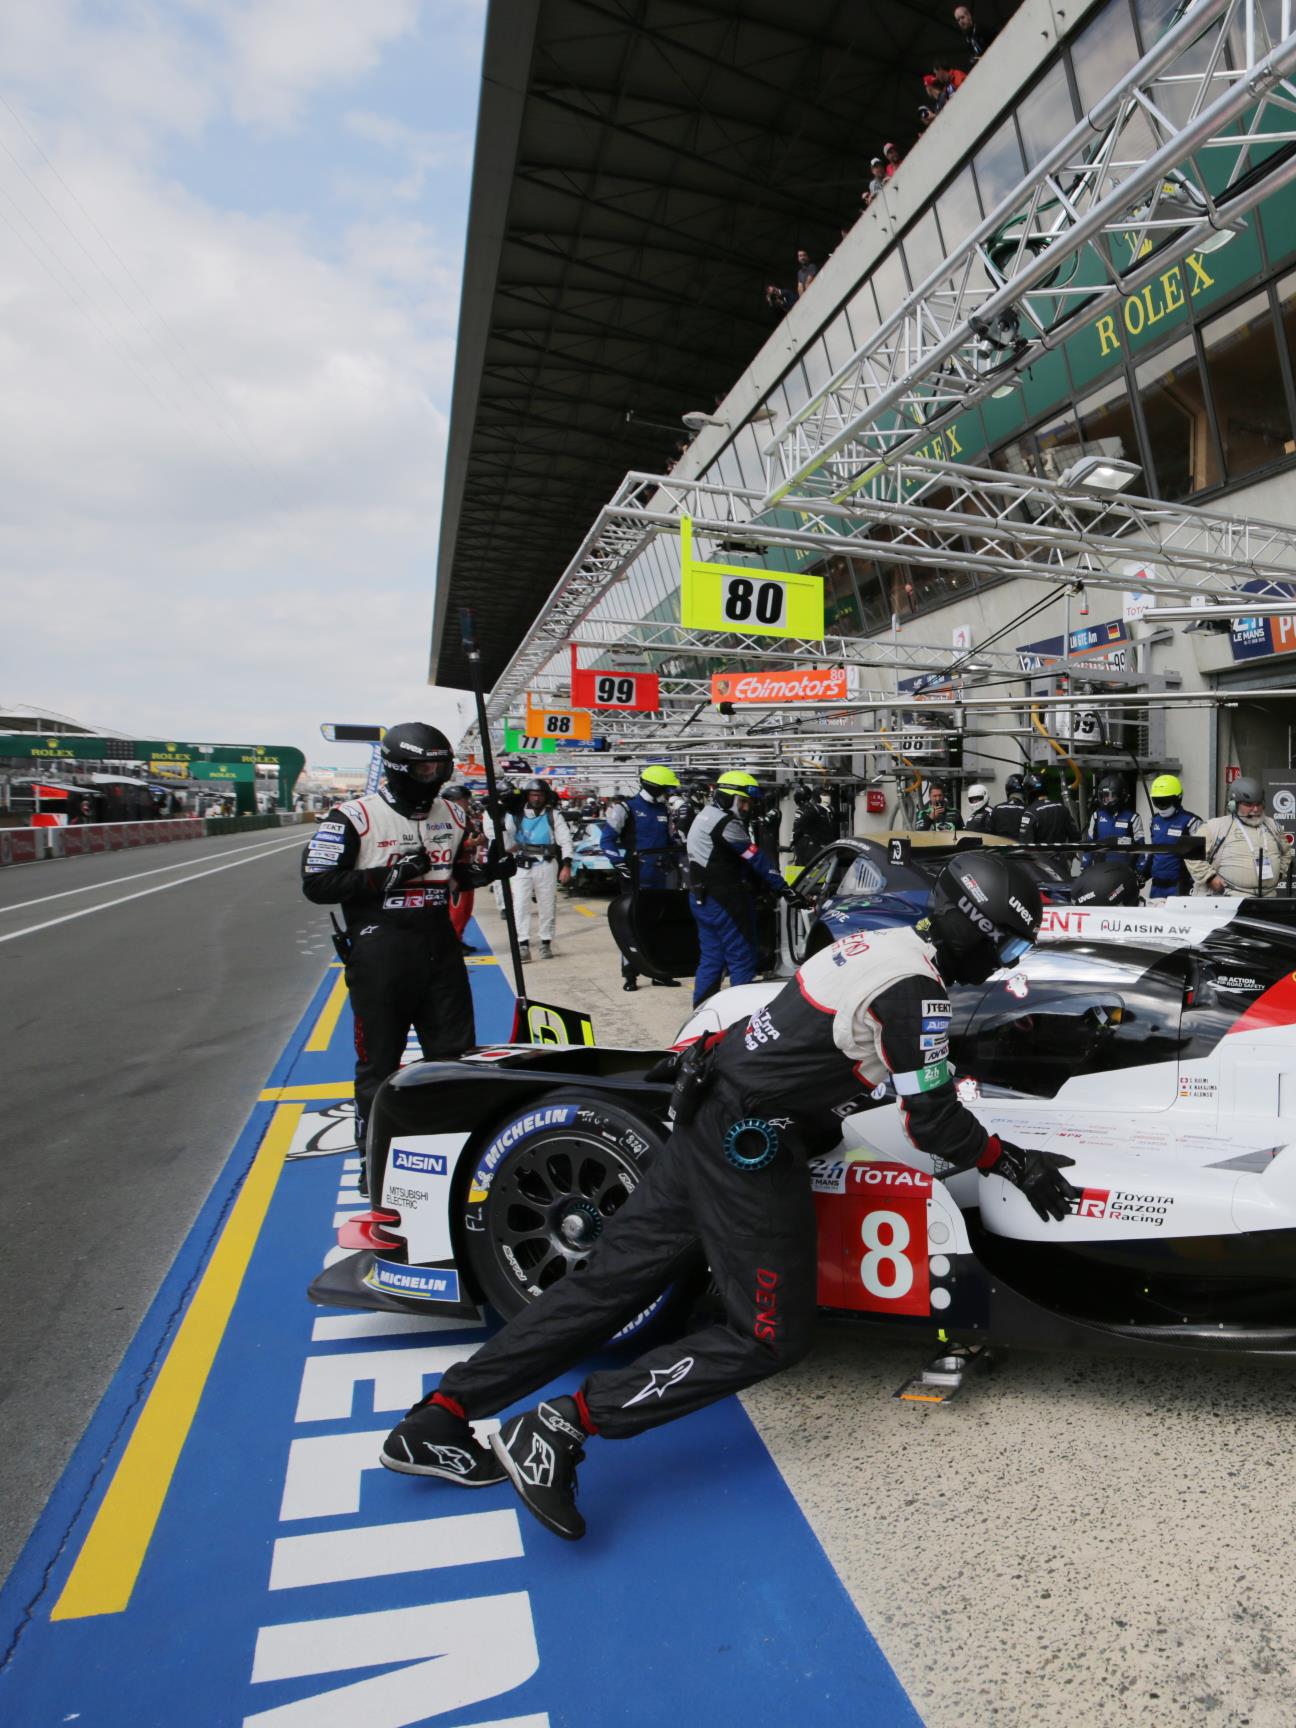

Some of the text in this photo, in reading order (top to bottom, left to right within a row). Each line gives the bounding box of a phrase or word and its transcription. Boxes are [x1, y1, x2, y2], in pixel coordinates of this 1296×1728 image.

[1096, 254, 1215, 356] ROLEX
[725, 578, 784, 624] 80
[1243, 630, 1265, 640] MANS
[830, 670, 845, 681] 80
[598, 678, 633, 703] 99
[735, 677, 841, 699] Ebimotors
[547, 716, 570, 732] 88
[31, 749, 75, 757] ROLEX
[400, 742, 424, 754] uvex
[152, 752, 191, 761] ROLEX
[242, 755, 279, 763] ROLEX
[385, 896, 425, 908] GR
[1078, 892, 1096, 903] uvex
[1008, 896, 1033, 925] uvex
[958, 897, 1004, 943] uvex
[1041, 911, 1091, 932] ENT
[1124, 924, 1191, 934] AISIN AW
[927, 1003, 951, 1014] JTEKT
[484, 1109, 569, 1169] MICHELIN
[396, 1153, 443, 1171] AISIN
[853, 1166, 929, 1187] TOTAL
[389, 1186, 429, 1201] MITSUBISHI
[1114, 1192, 1175, 1204] TOYOTA
[386, 1195, 418, 1209] ELECTRIC
[1111, 1202, 1167, 1214] GAZOO
[1109, 1211, 1164, 1226] Racing
[860, 1210, 914, 1299] 8
[379, 1270, 447, 1291] MICHELIN
[754, 1267, 778, 1342] DENS
